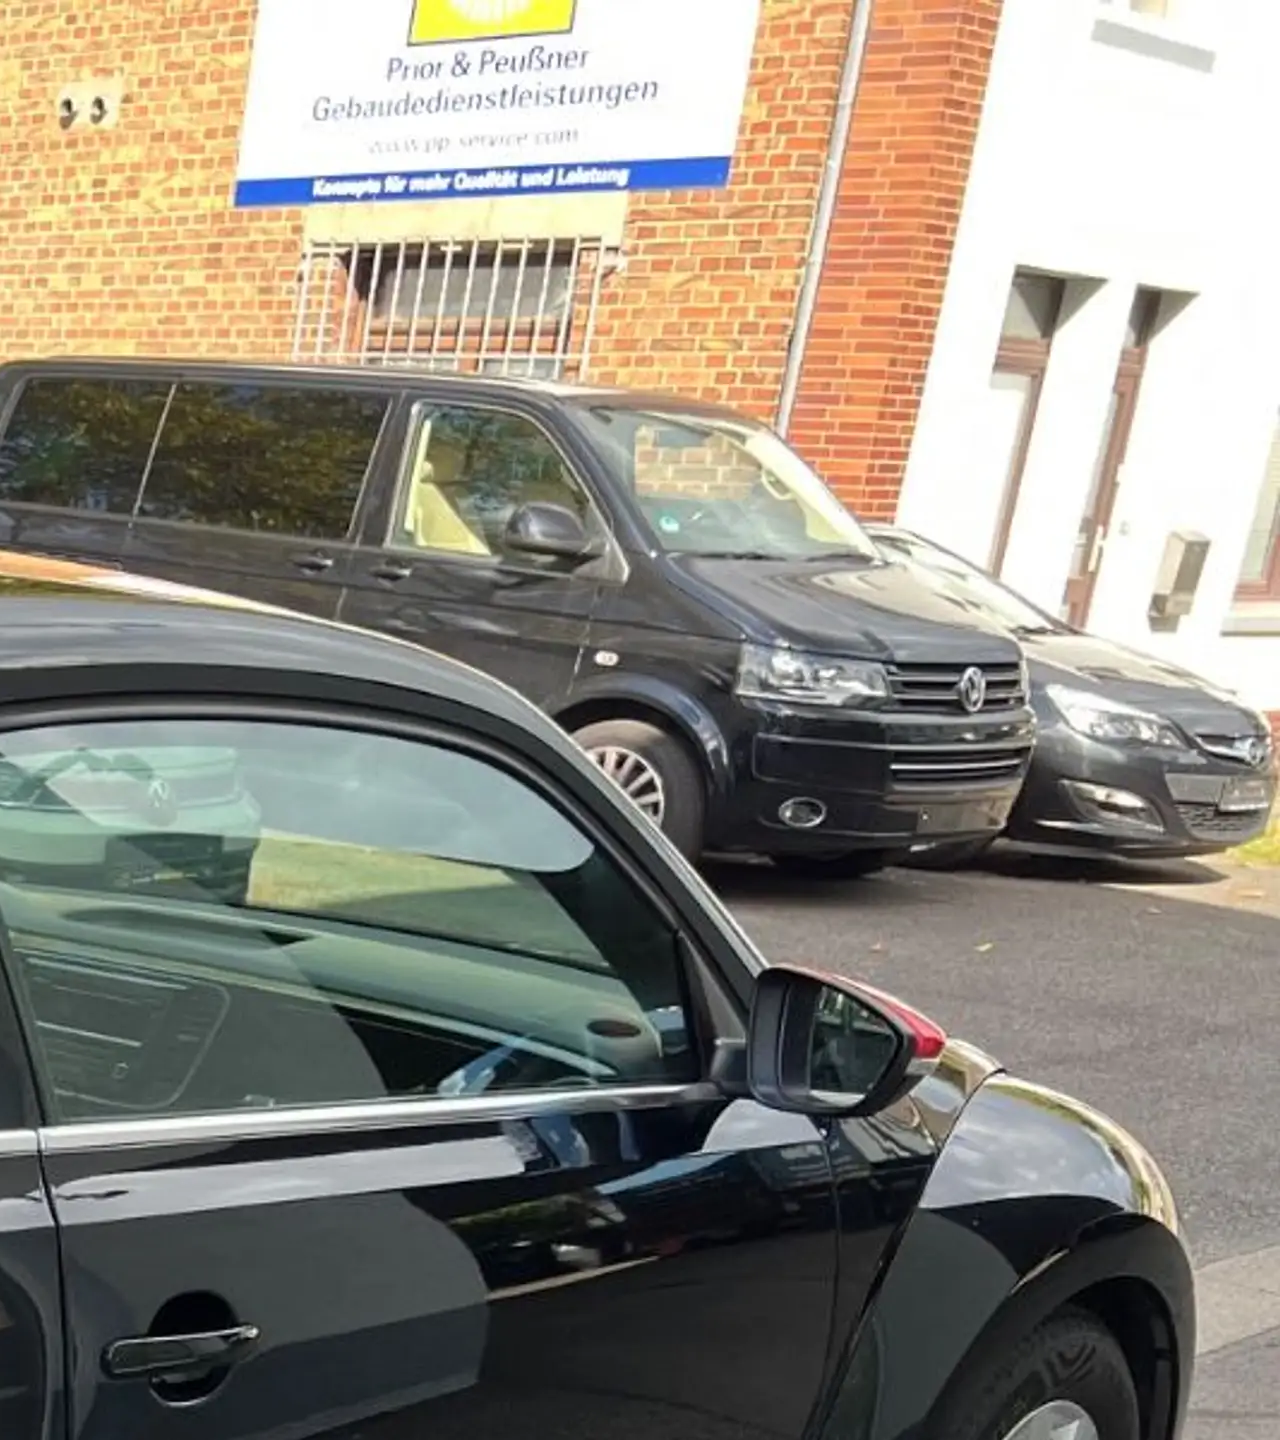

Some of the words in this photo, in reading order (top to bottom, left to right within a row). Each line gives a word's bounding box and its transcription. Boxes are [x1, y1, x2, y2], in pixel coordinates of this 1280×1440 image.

[387, 57, 444, 82] Prior
[450, 51, 472, 78] &
[478, 45, 590, 75] Peußner
[409, 173, 452, 193] mehr
[520, 168, 554, 187] und
